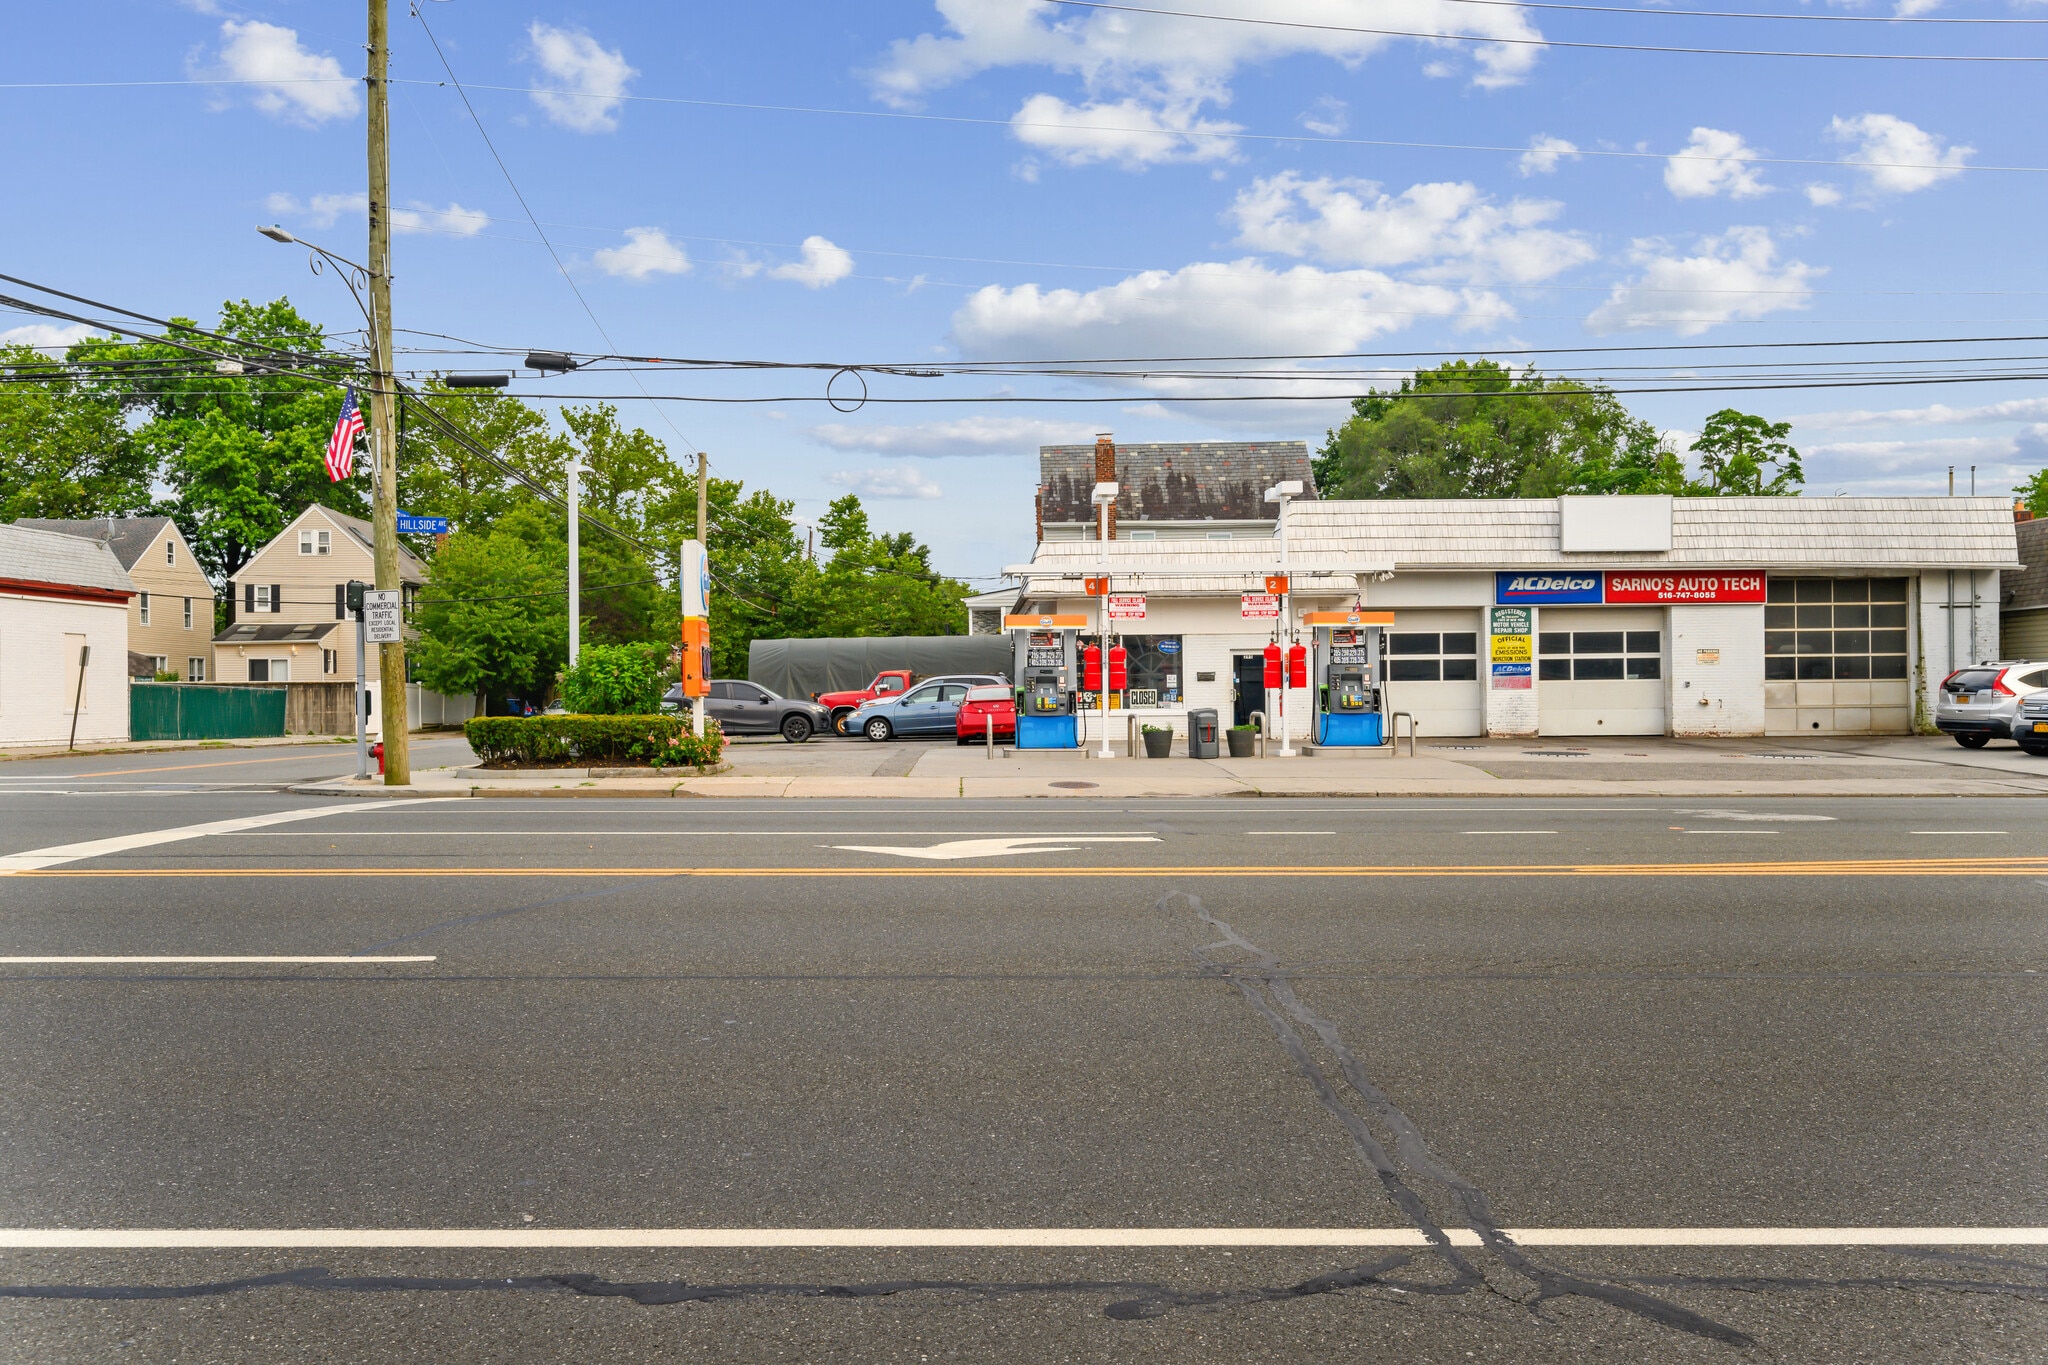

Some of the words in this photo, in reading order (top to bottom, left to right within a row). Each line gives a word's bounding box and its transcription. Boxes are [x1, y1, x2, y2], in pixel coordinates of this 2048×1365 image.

[400, 519, 437, 530] HILLSIDE
[1088, 581, 1096, 590] 4
[1269, 580, 1277, 589] 2
[1508, 576, 1596, 591] ACDelco
[1612, 577, 1675, 591] SARNO'S
[1678, 577, 1718, 591] AUTO
[1722, 577, 1760, 591] TECH
[377, 593, 386, 601] NO
[366, 602, 398, 610] COMMERCIAL
[372, 611, 392, 619] TRAFFIC
[1495, 608, 1527, 618] REGISTERED
[1131, 690, 1155, 704] CLOSED
